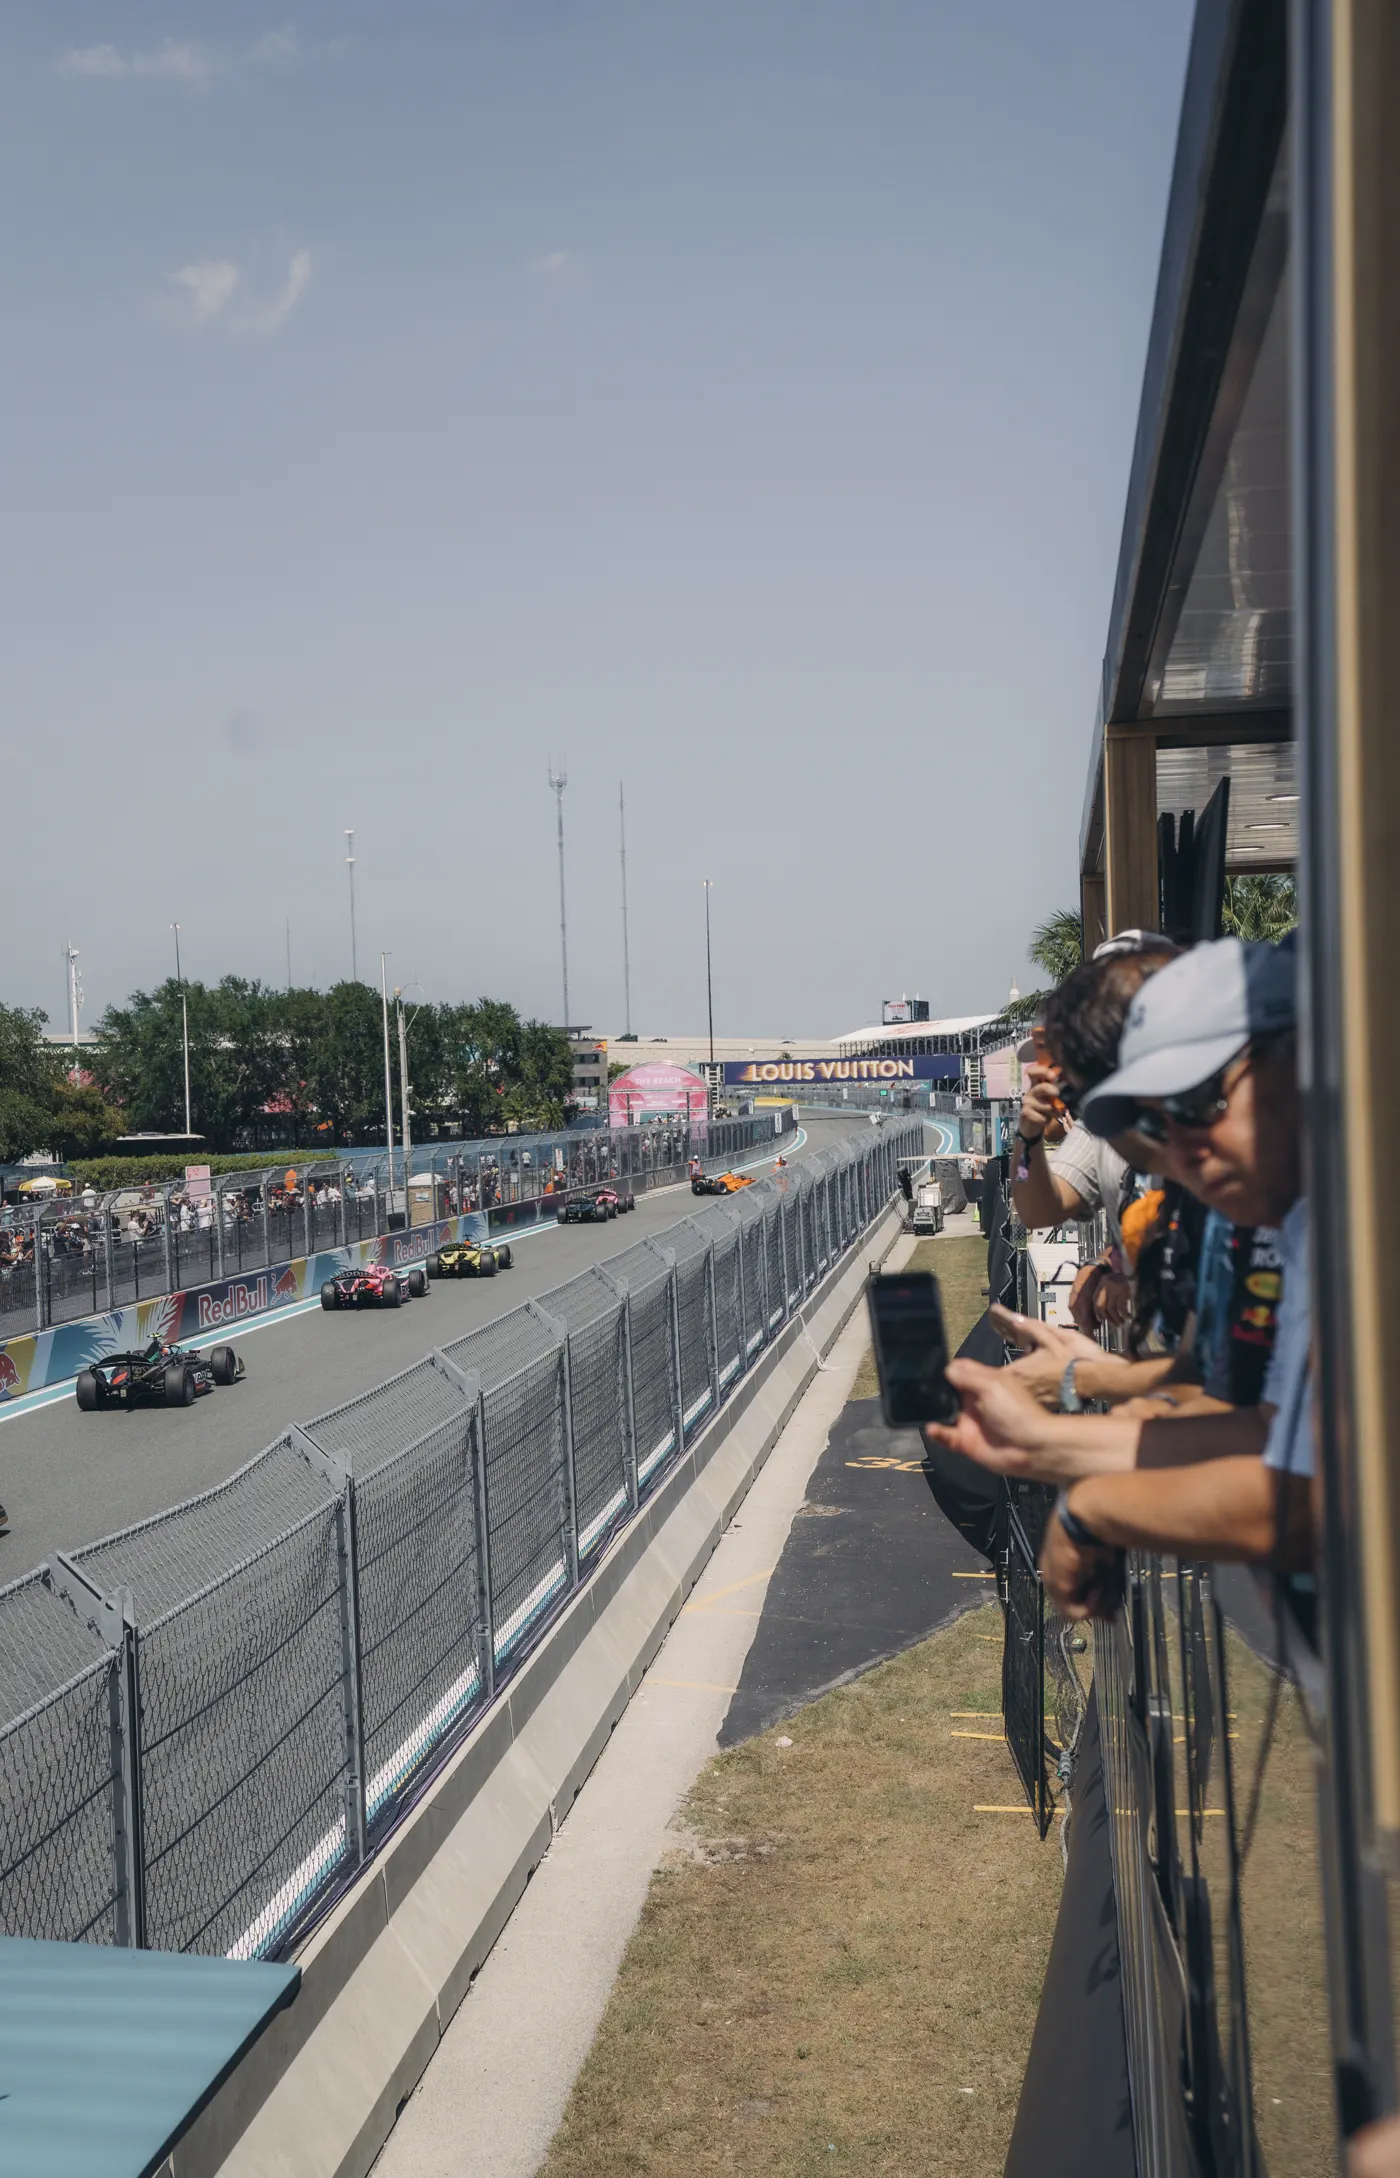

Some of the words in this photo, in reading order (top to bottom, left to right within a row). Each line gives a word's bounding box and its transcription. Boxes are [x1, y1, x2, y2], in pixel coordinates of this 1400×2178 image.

[750, 1061, 815, 1082] LOUIS
[819, 1059, 914, 1080] VUITTON
[635, 1078, 651, 1086] THE
[652, 1077, 681, 1085] BEACH
